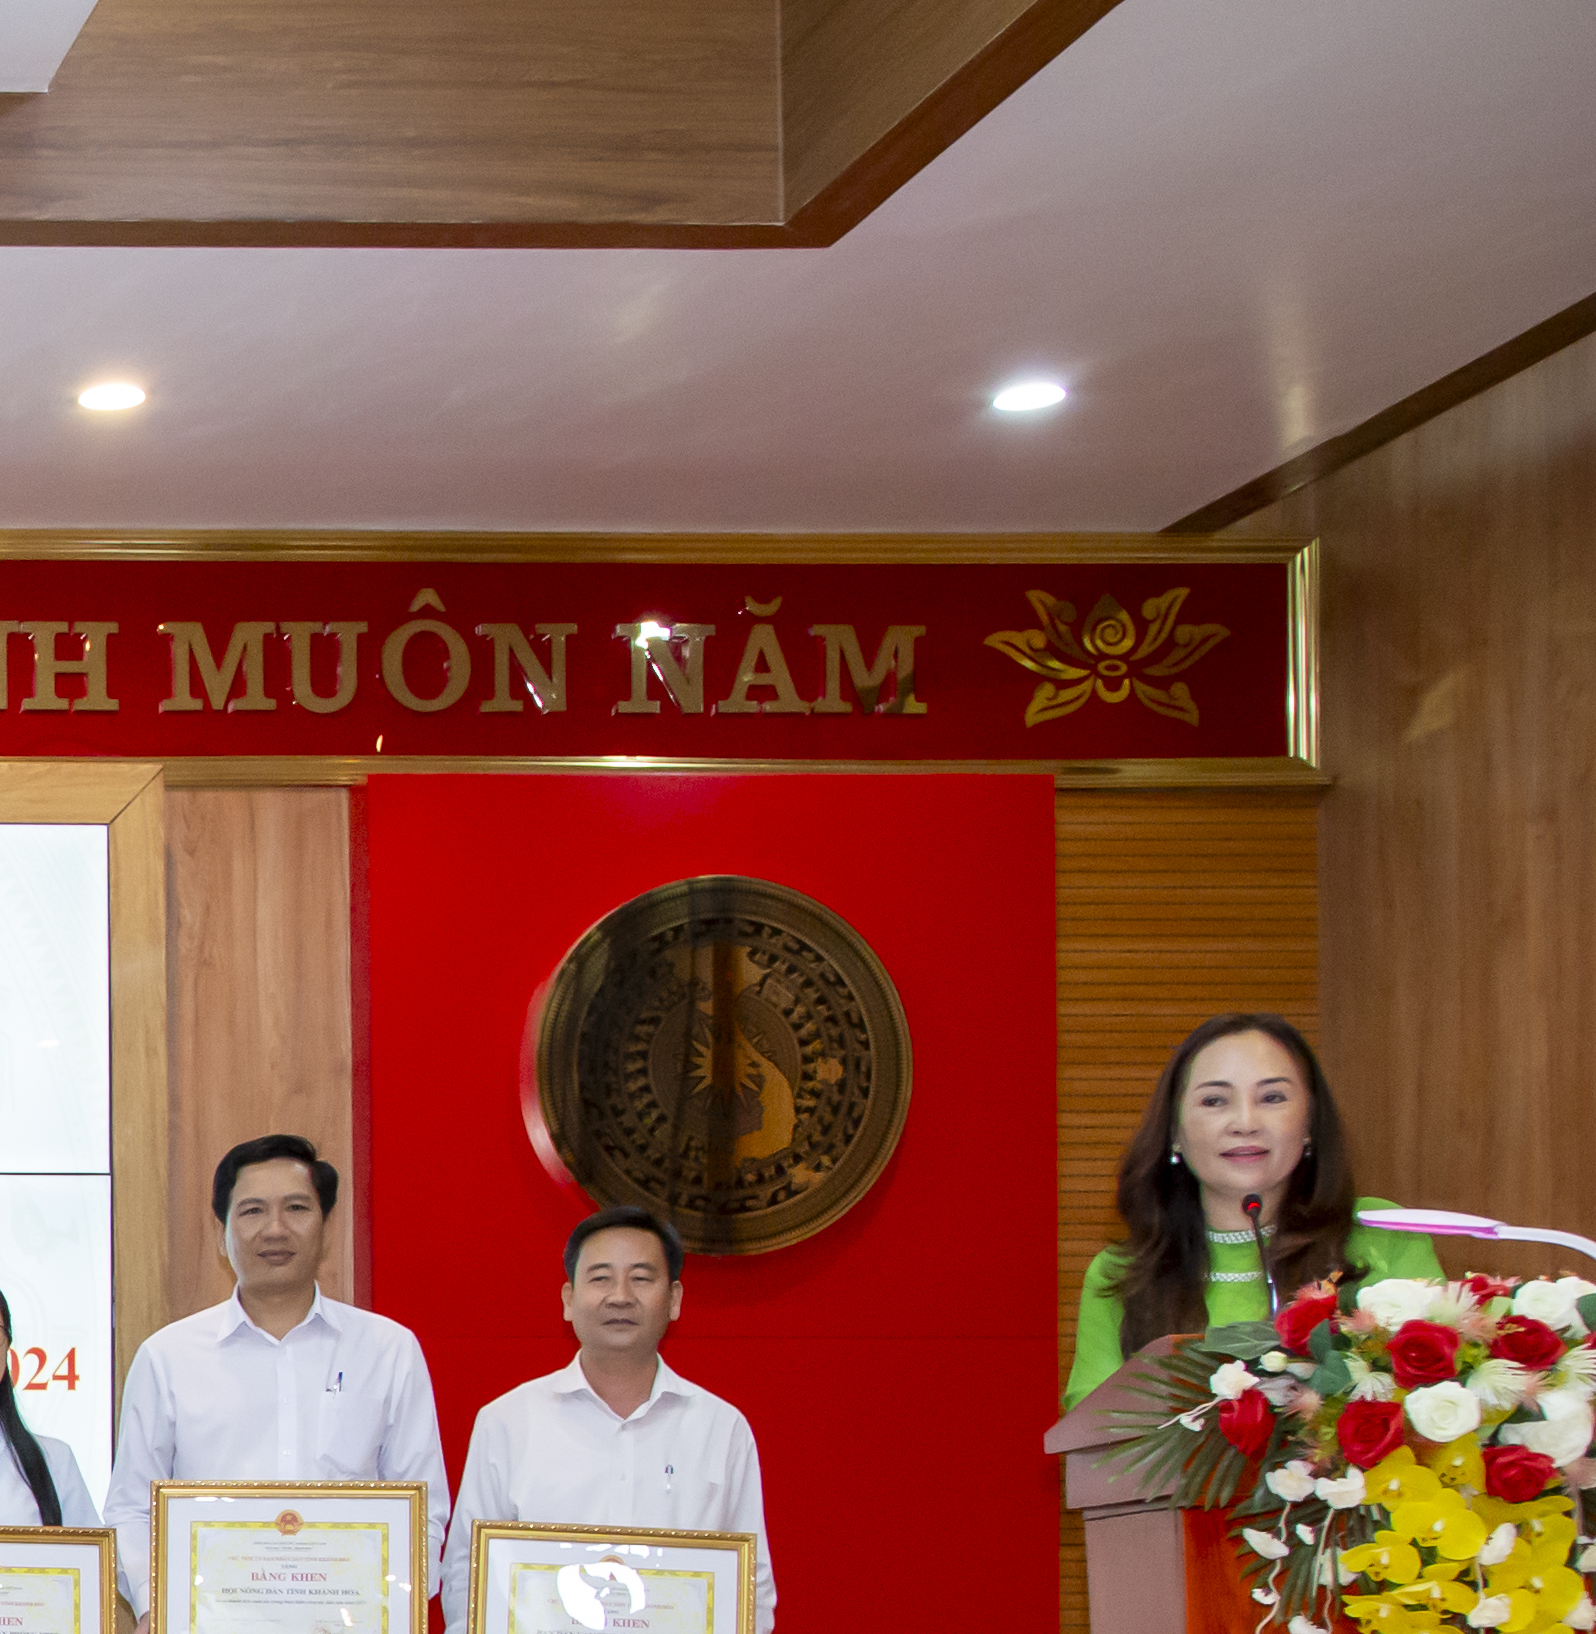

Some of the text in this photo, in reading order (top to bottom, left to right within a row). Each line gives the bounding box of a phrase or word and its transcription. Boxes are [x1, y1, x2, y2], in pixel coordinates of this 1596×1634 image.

[158, 587, 577, 715] MUÔN
[613, 595, 927, 717] NĂM
[291, 1572, 327, 1582] KHEN
[612, 1618, 650, 1628] KHEN
